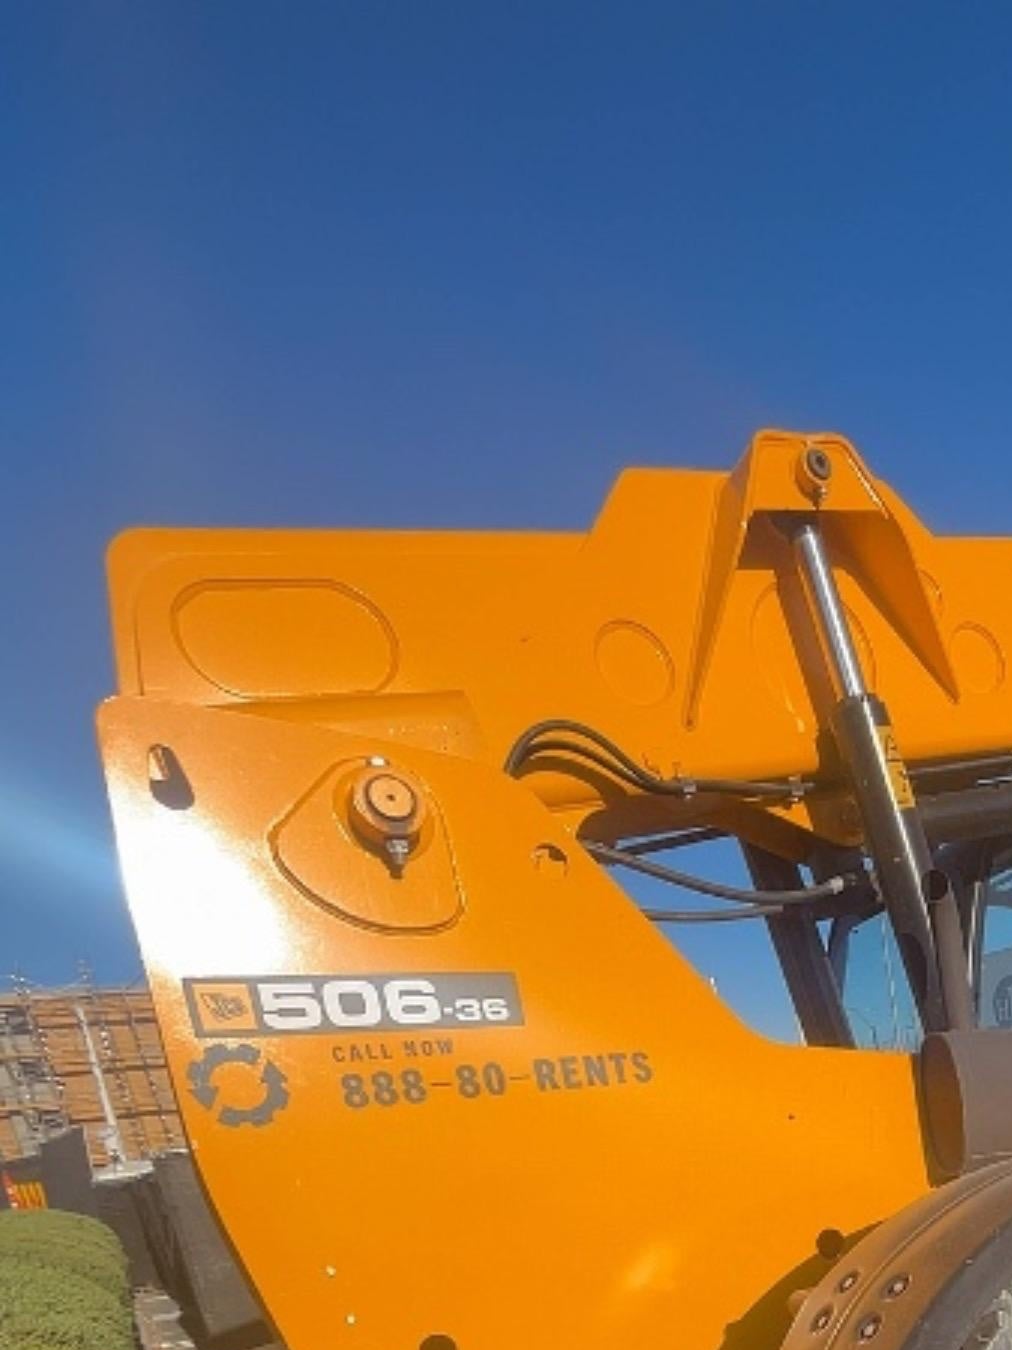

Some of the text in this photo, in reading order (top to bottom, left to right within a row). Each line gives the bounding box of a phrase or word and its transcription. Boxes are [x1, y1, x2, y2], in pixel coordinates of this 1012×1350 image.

[331, 1039, 455, 1064] CALL NOW
[340, 1052, 654, 1109] 888-80-RENTS
